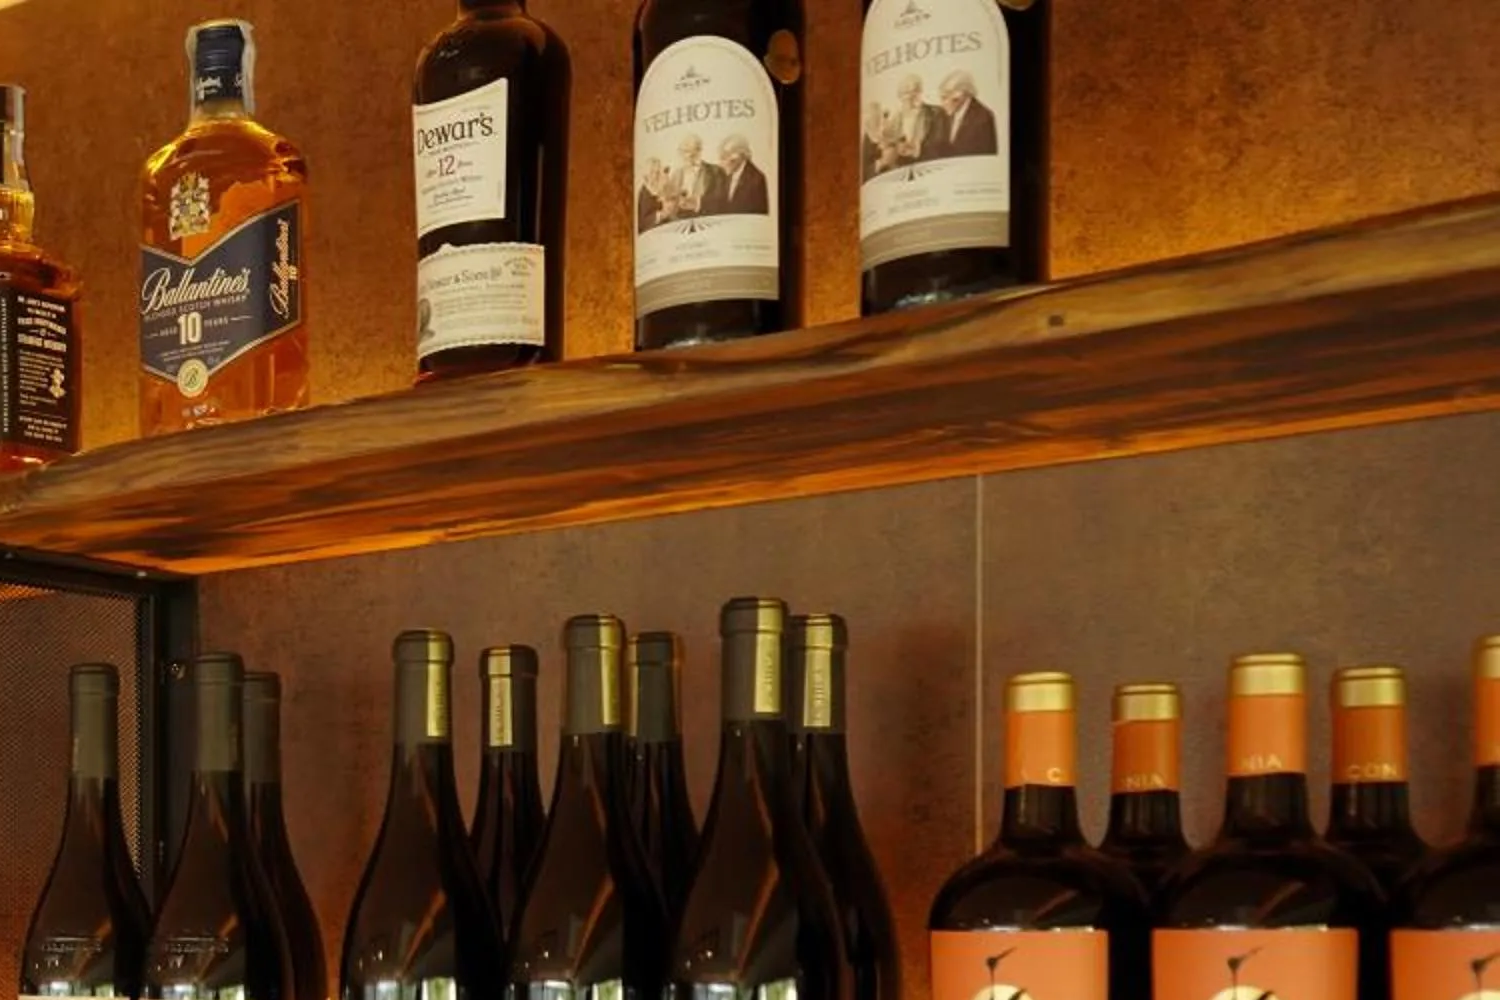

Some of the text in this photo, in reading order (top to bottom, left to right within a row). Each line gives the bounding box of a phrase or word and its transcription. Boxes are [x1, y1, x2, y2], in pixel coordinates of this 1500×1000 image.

[417, 112, 494, 156] Dewar's
[643, 98, 756, 134] VELHOTES
[438, 154, 456, 178] 12
[141, 266, 251, 315] Ballantine's
[177, 311, 203, 346] 10
